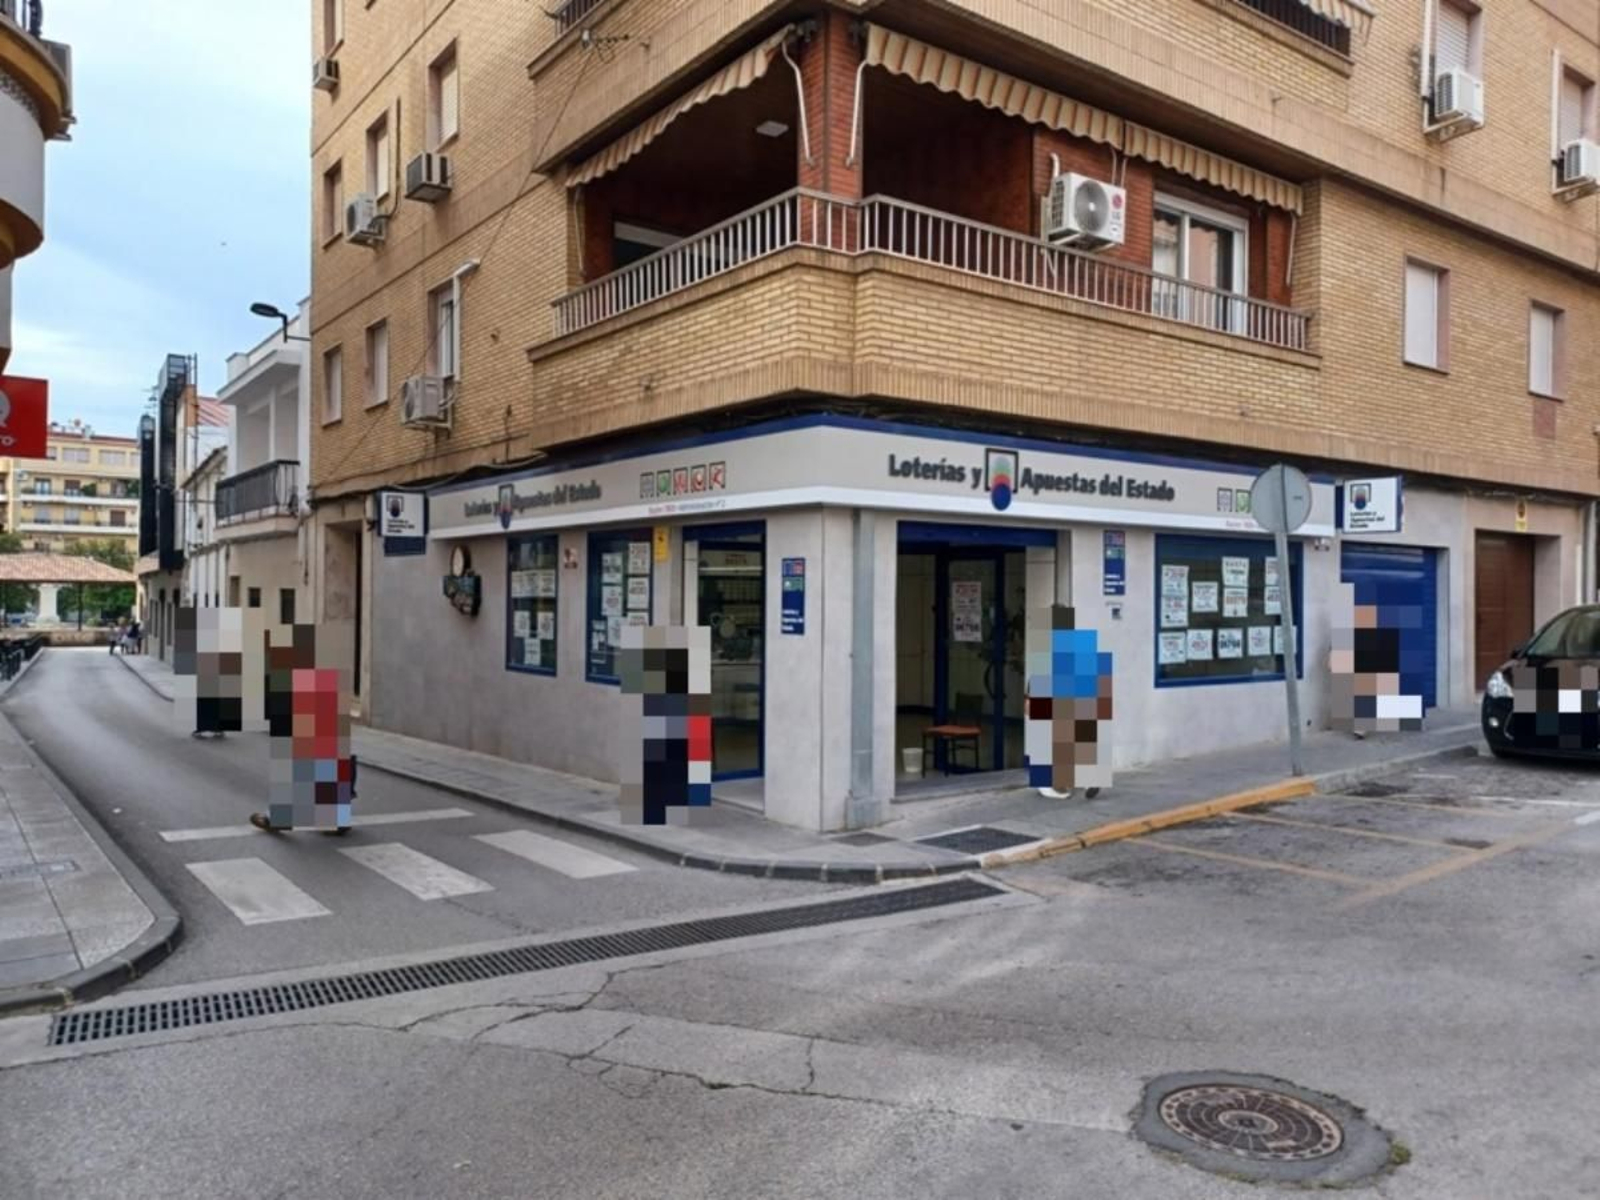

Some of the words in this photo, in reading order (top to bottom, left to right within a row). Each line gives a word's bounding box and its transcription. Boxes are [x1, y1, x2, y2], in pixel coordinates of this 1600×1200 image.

[888, 453, 966, 483] Loterías
[971, 466, 982, 490] y
[1020, 466, 1096, 496] Apuestas
[1099, 473, 1123, 497] del
[1126, 478, 1175, 502] Estado
